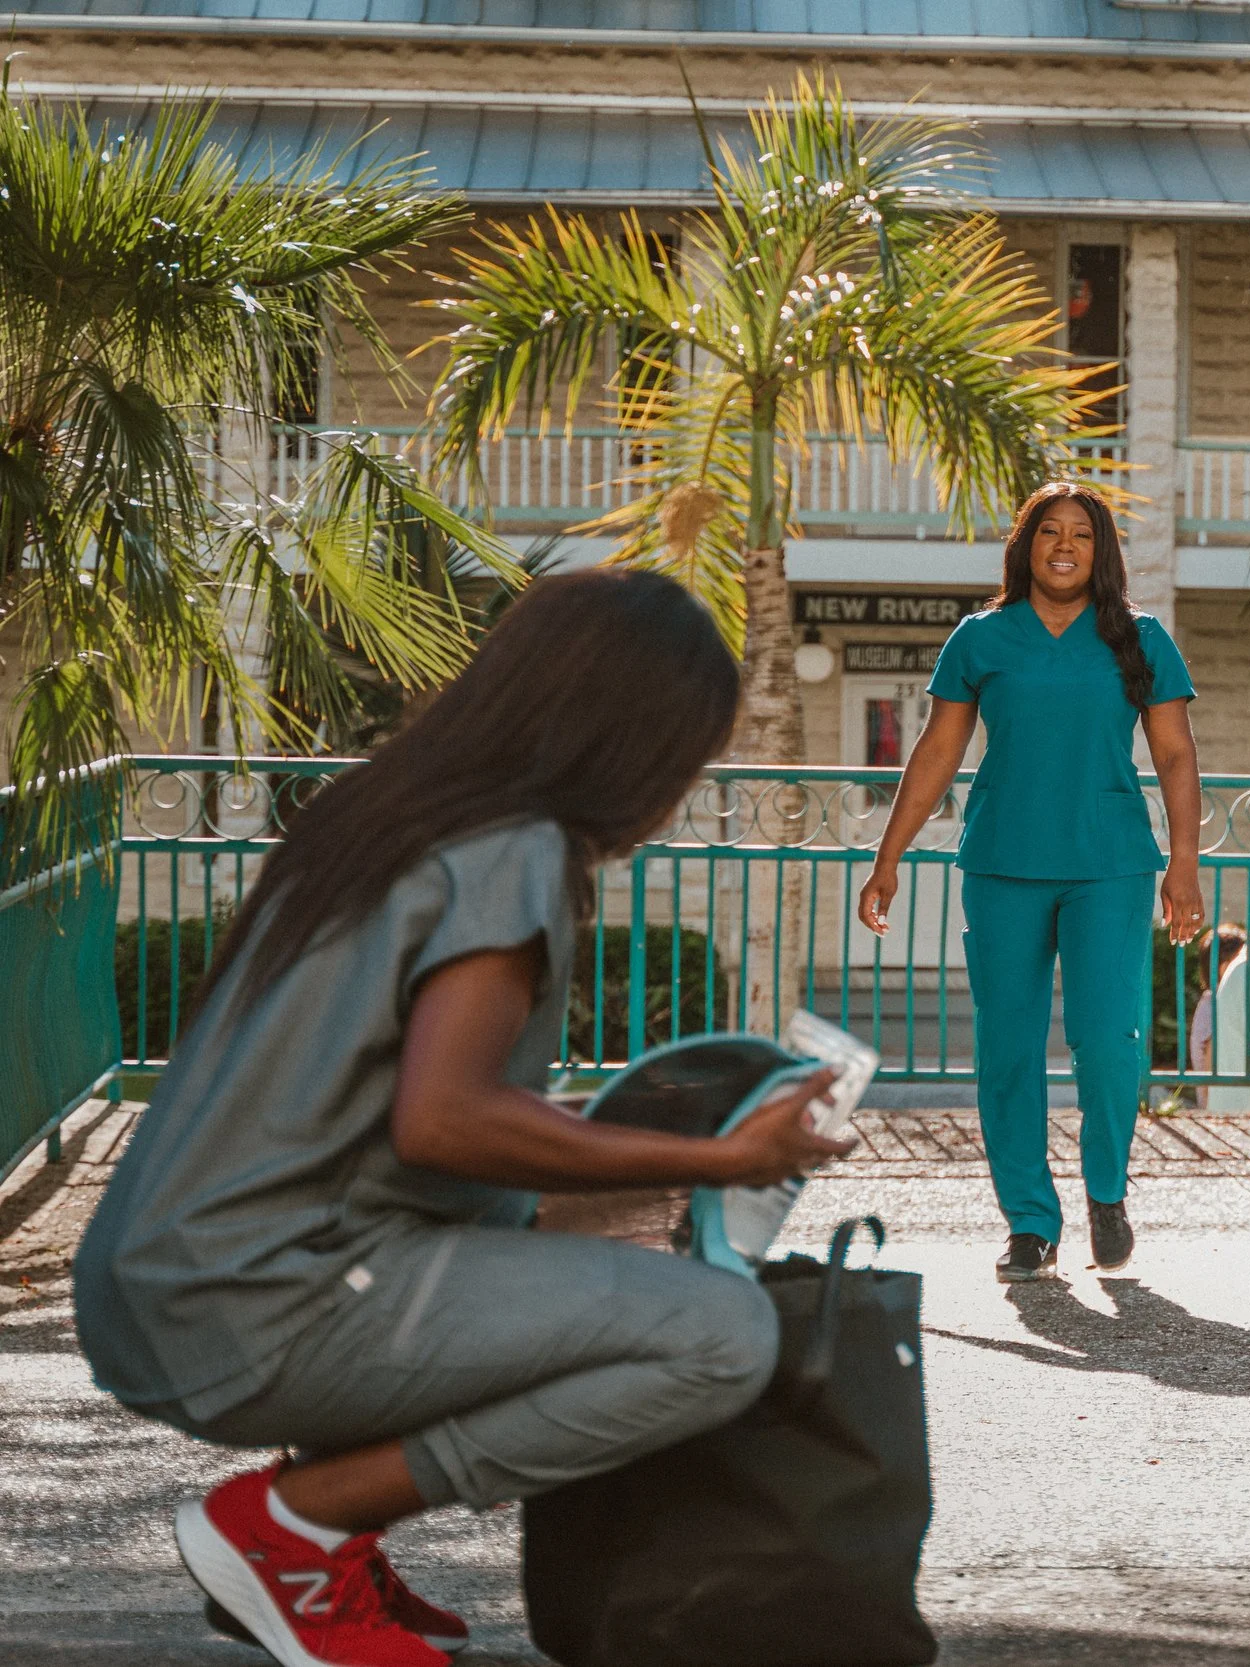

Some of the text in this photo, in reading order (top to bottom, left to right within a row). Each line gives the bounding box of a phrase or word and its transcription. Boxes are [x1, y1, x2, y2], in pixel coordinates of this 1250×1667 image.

[805, 596, 868, 620] NEW
[877, 597, 961, 622] RIVER
[846, 645, 903, 669] MUSEUM
